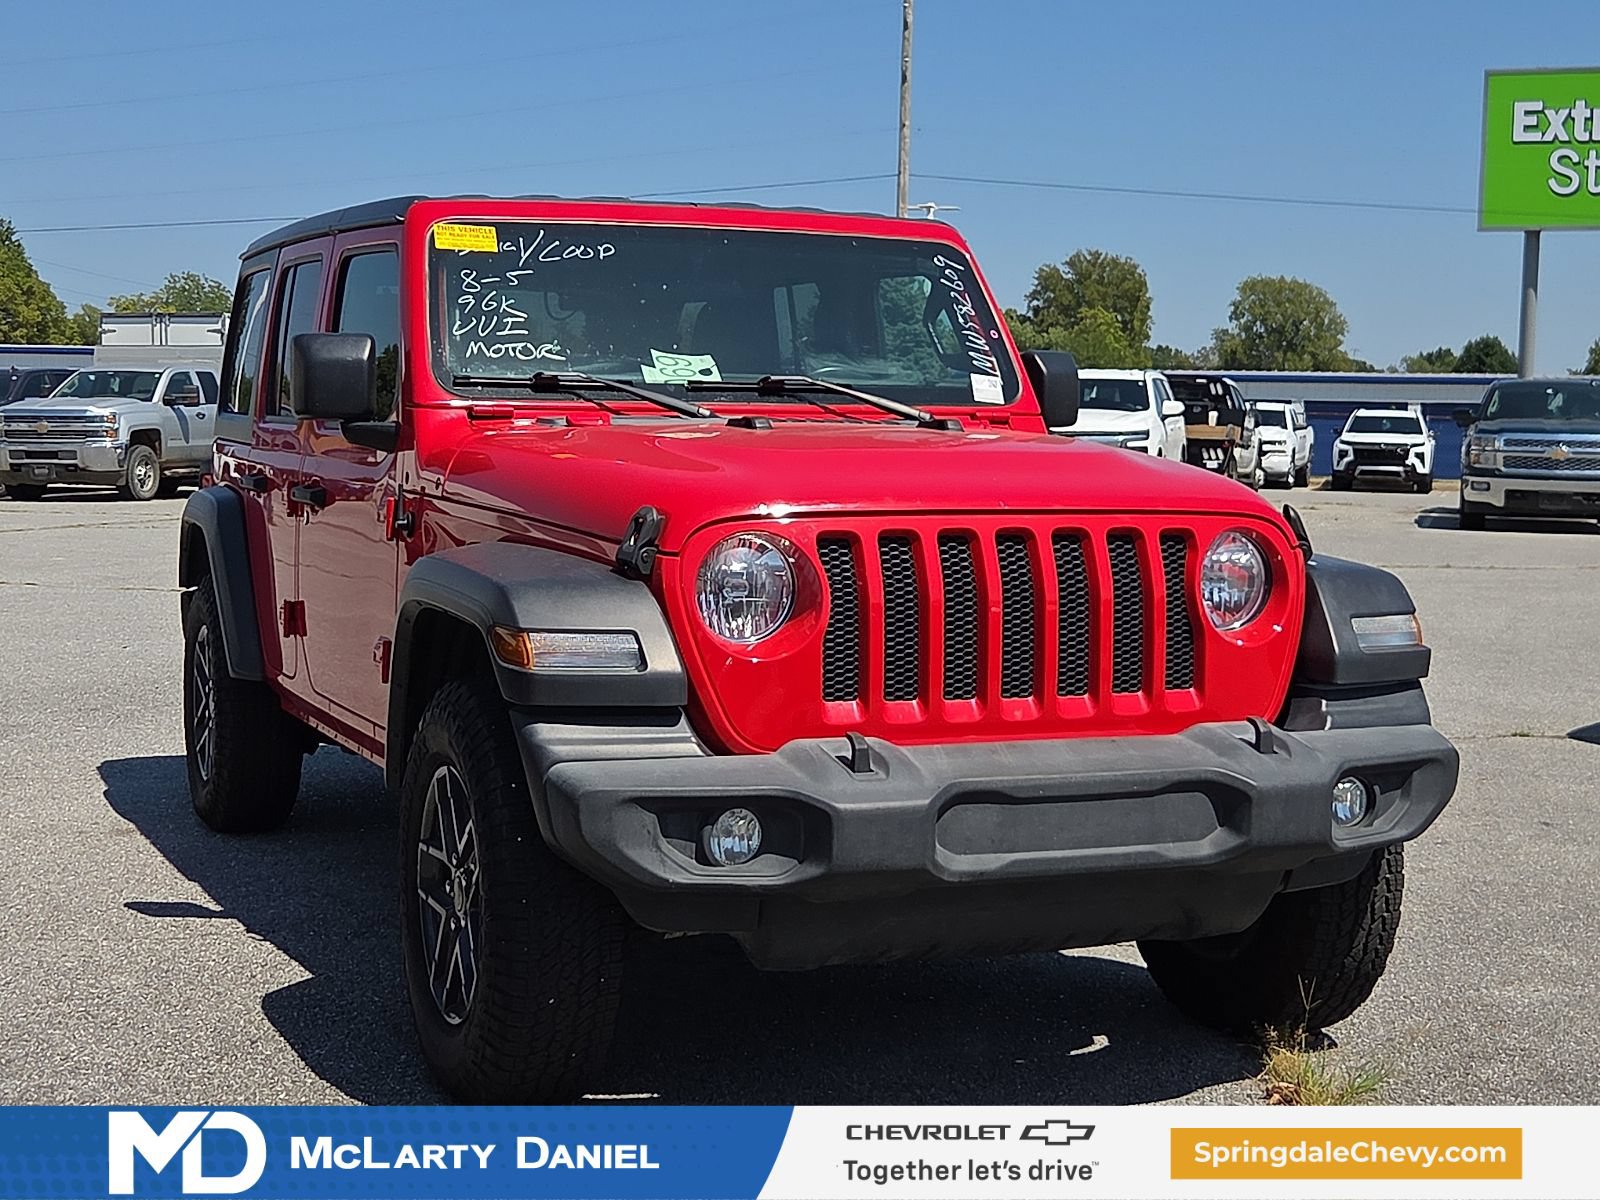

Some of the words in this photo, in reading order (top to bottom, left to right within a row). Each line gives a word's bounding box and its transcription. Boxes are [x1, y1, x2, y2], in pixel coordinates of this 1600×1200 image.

[436, 224, 456, 232] THIS
[458, 226, 494, 235] VEHICLE
[465, 340, 567, 361] MOTOR
